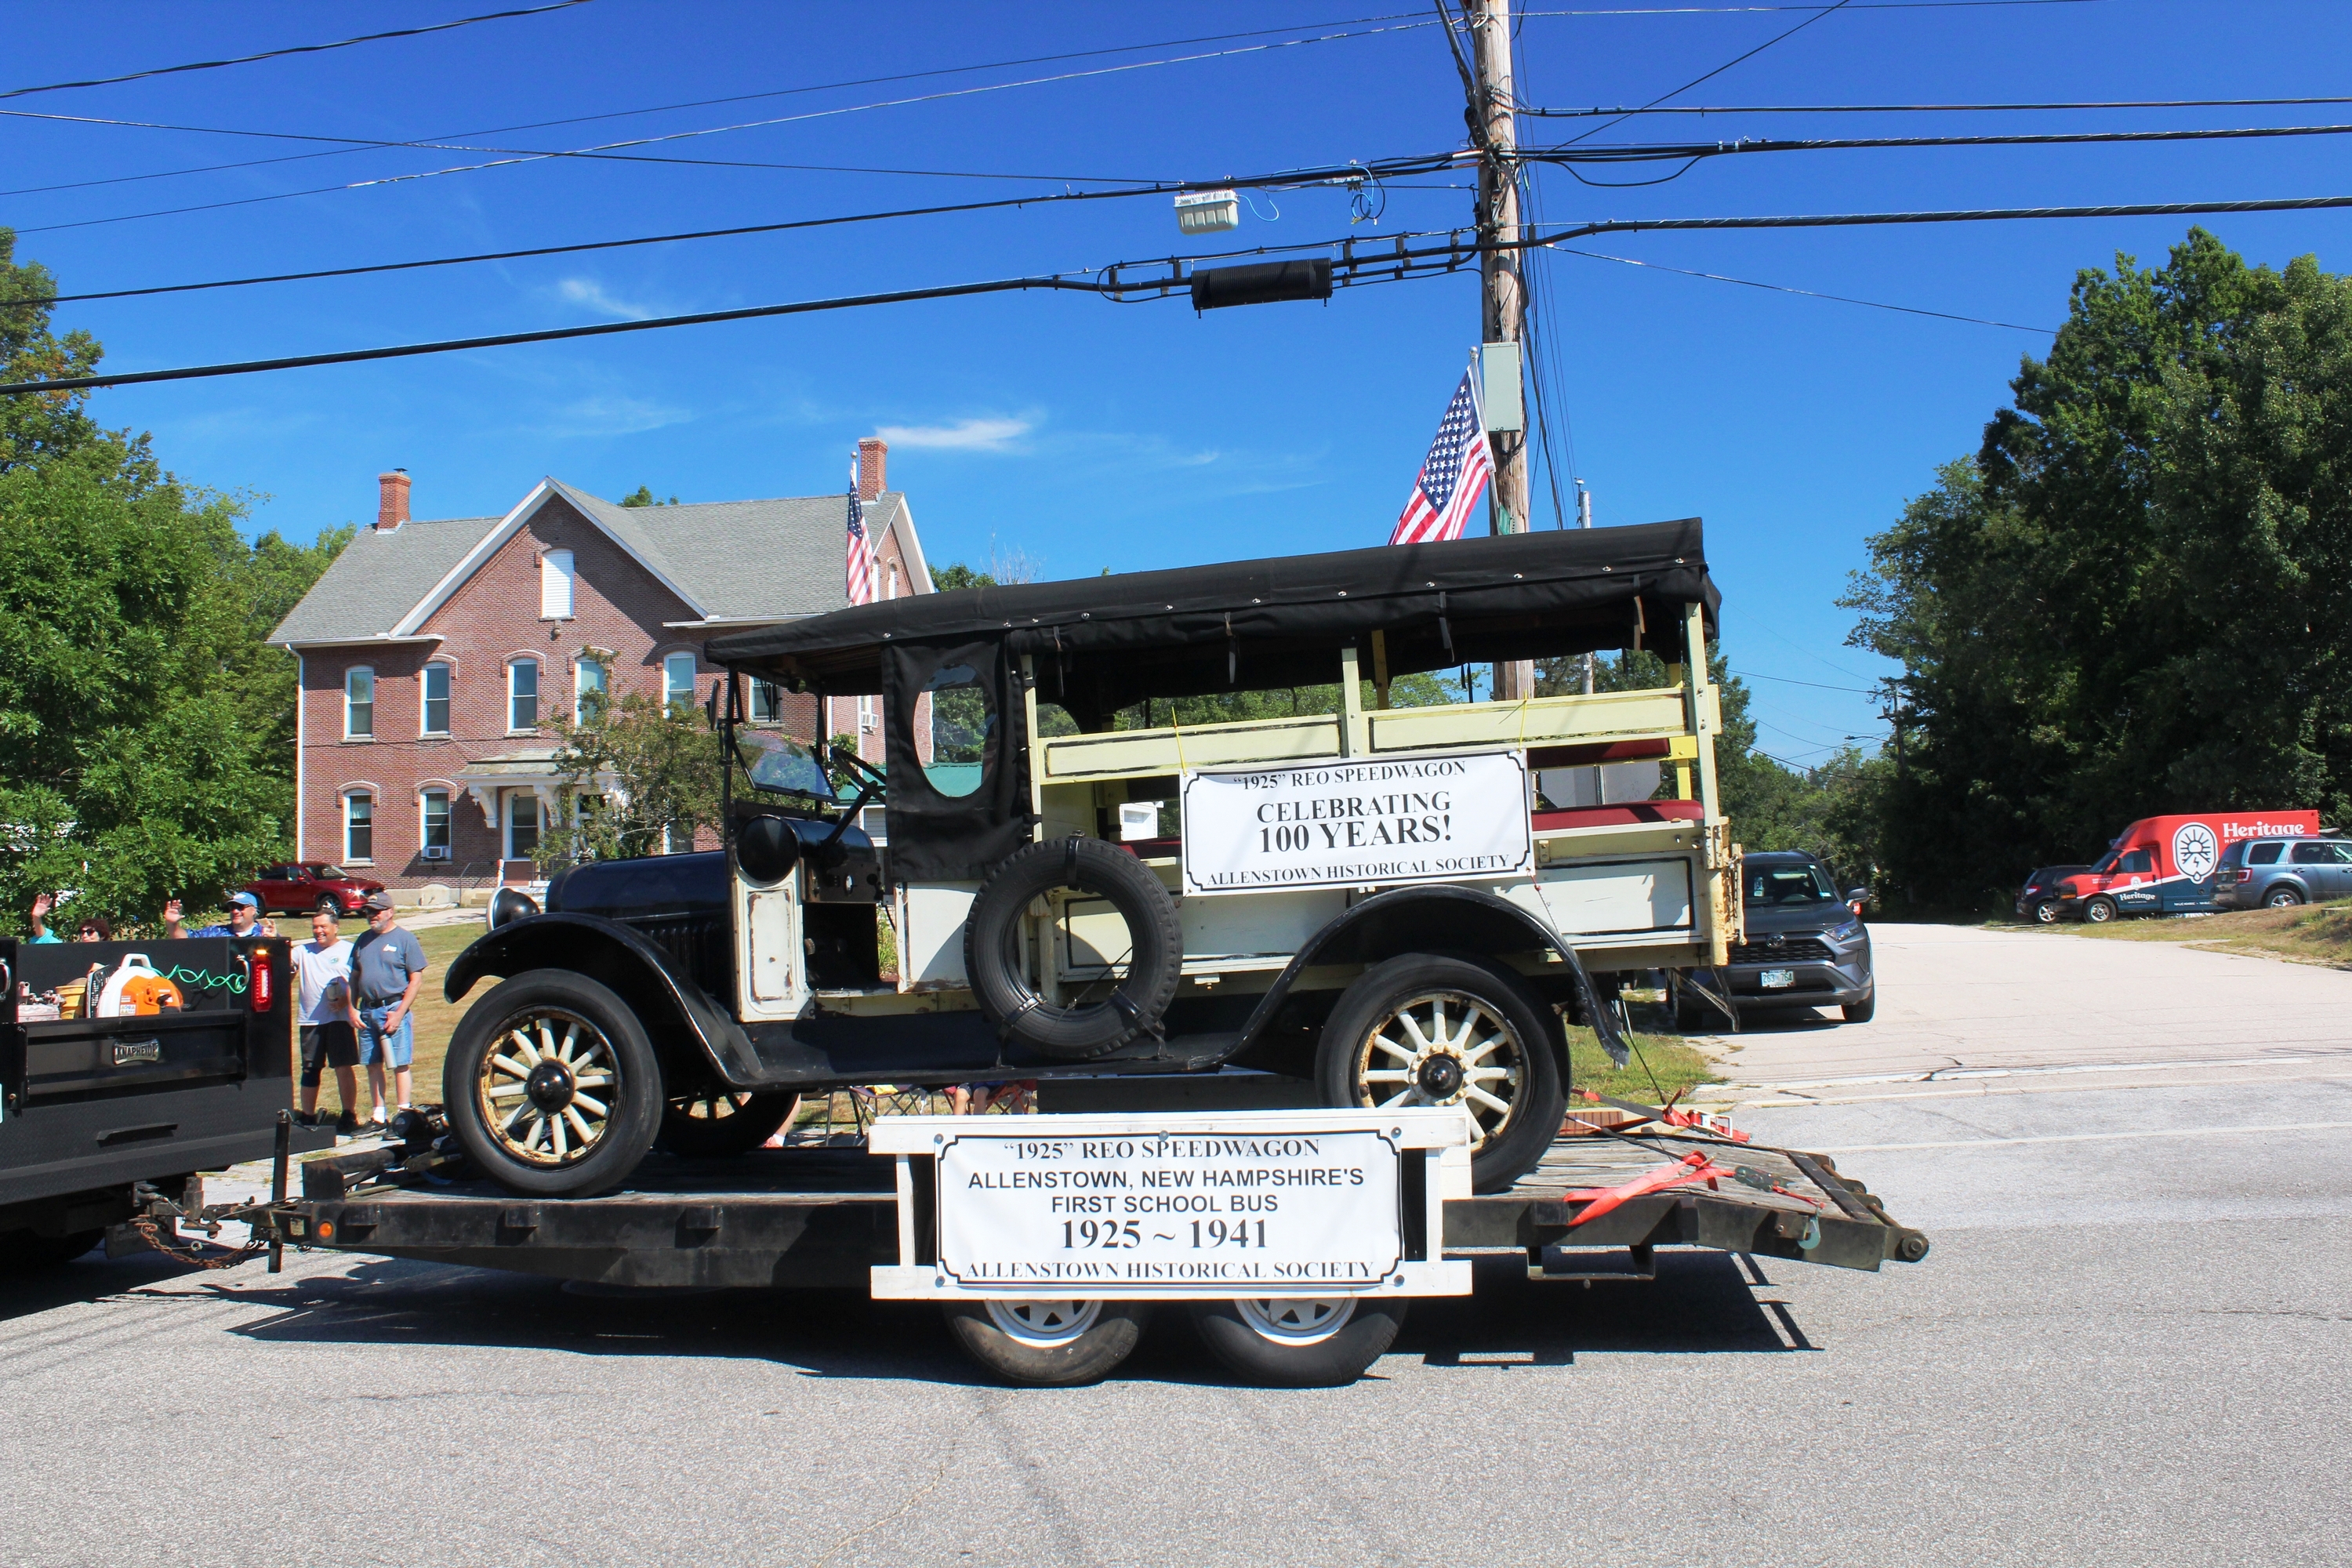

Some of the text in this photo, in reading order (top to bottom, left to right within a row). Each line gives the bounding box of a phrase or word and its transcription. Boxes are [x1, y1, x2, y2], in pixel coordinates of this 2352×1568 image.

[1290, 771, 1330, 787] REO
[1334, 760, 1466, 783] SPEEDWAGON
[1256, 791, 1451, 823] CELEBRATING
[1259, 814, 1452, 853] 100 YEARS!
[2223, 821, 2305, 837] Heritage
[1207, 854, 1509, 886] ALLENSTOWN HISTORICAL SOCIETY
[2119, 891, 2156, 901] Heritage
[1763, 973, 1792, 983] 263 764
[1082, 1141, 1135, 1160] REO
[1141, 1138, 1319, 1159] SPEEDWAGON
[967, 1167, 1365, 1191] ALLENSTOWN, NEW HAMPSHIRE'S
[1051, 1194, 1279, 1214] FIRST SCHOOL BUS
[1061, 1218, 1142, 1250] 1925
[1189, 1219, 1267, 1250] 1941
[966, 1261, 1374, 1279] ALLENSTOWN HISTORICAL SOCIETY
